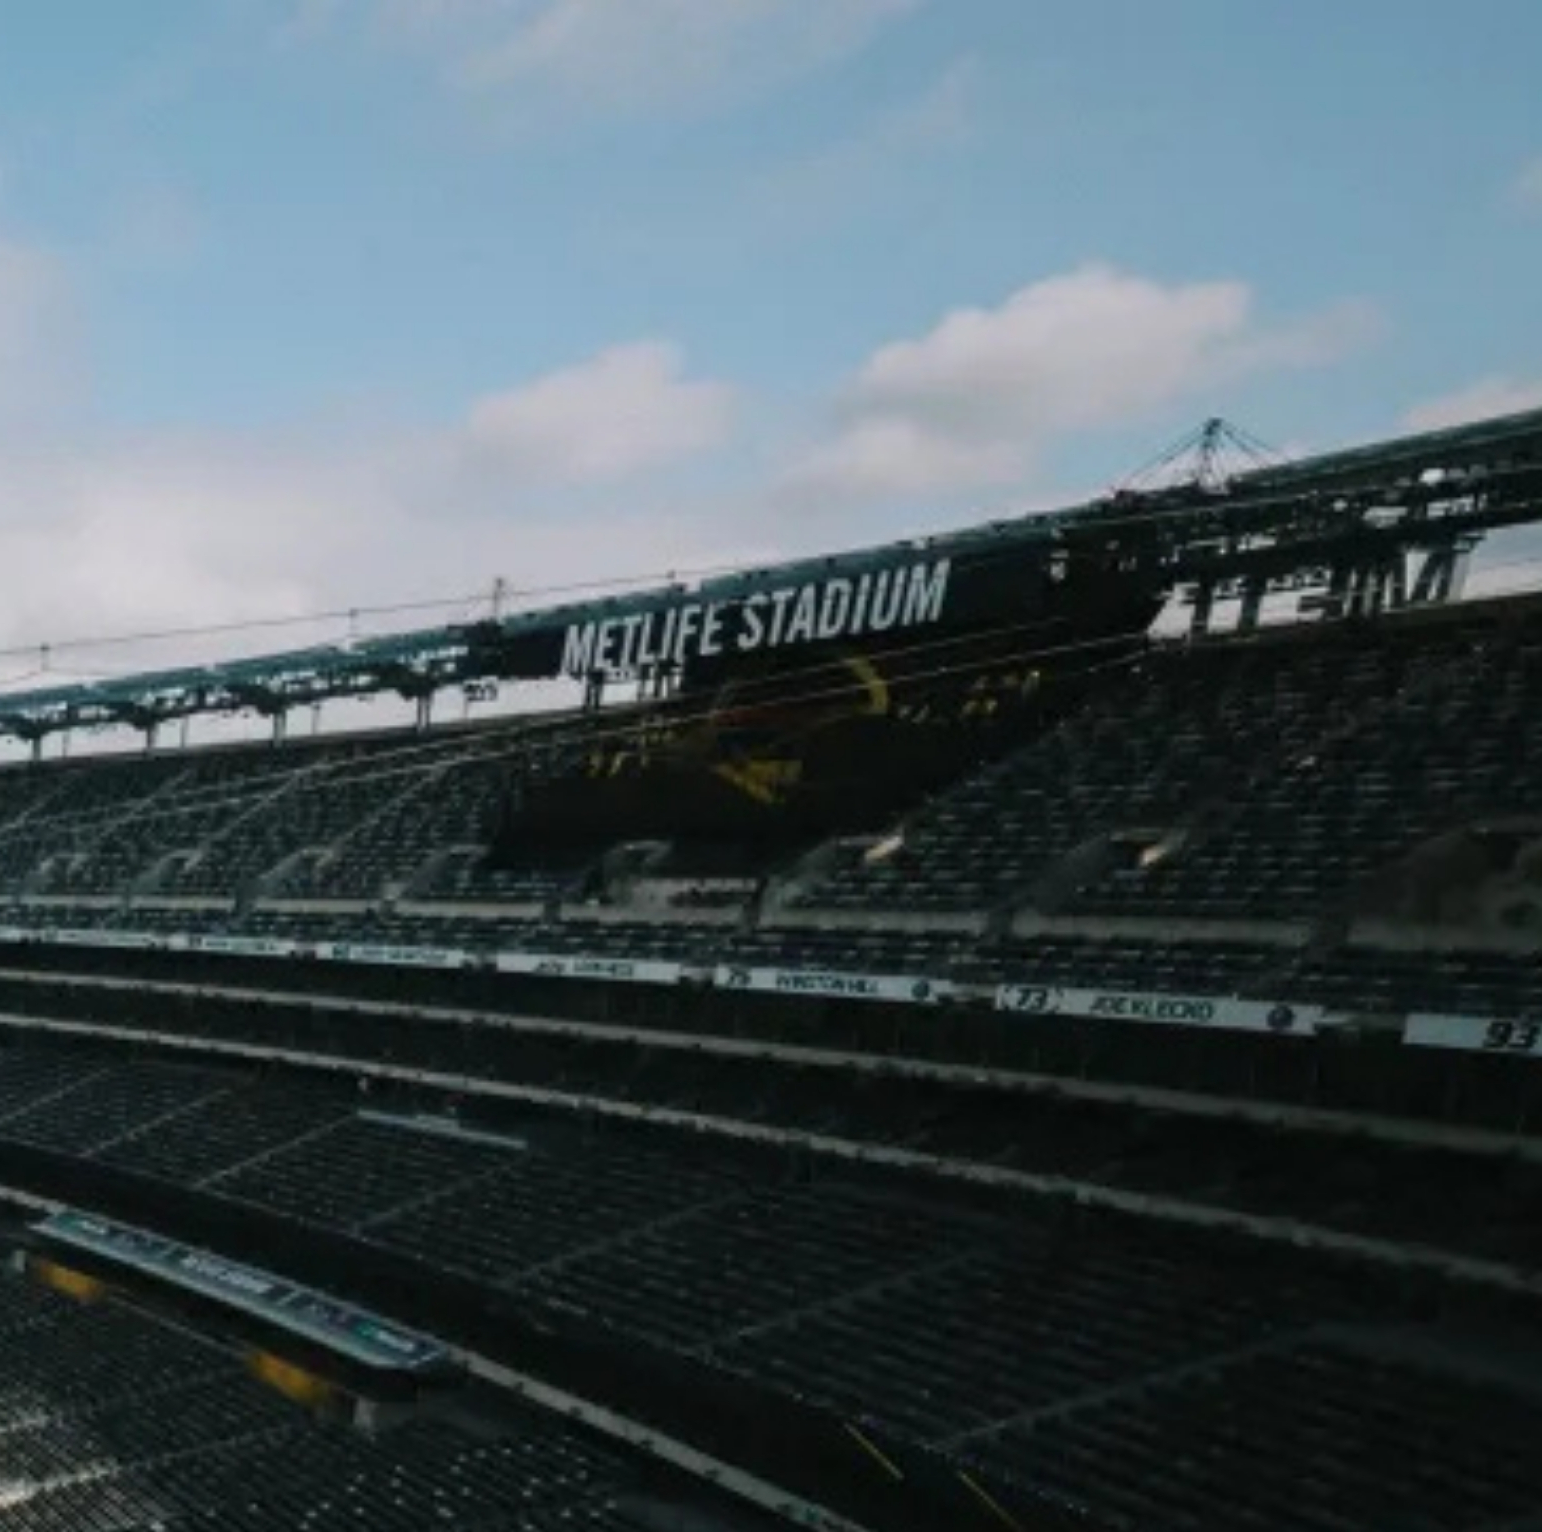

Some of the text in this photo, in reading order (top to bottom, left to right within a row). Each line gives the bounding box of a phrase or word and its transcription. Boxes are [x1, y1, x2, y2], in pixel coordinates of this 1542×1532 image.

[560, 557, 951, 675] METLIFE STADIUM
[1017, 987, 1048, 1010] 73
[1482, 1020, 1540, 1048] 93
